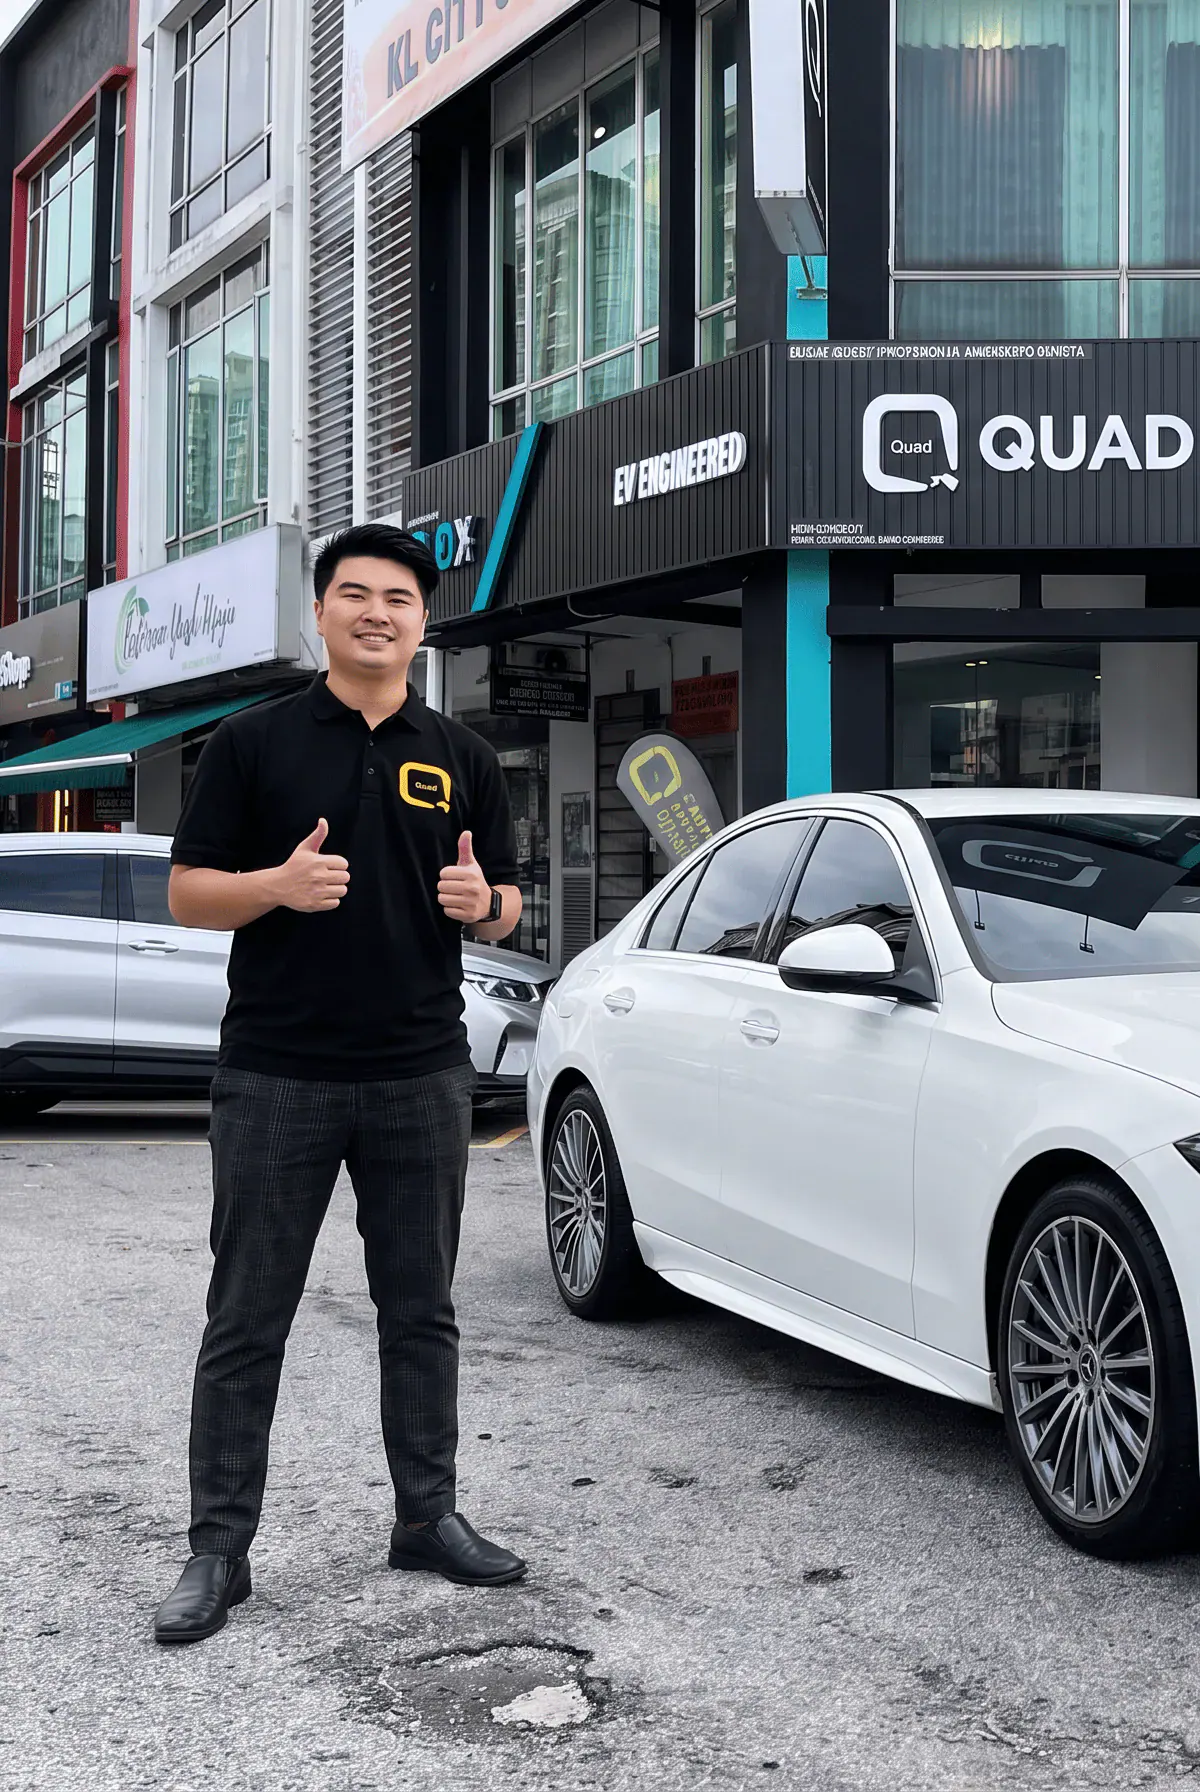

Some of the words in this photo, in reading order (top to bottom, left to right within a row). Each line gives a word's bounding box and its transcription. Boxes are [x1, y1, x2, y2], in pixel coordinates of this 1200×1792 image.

[387, 29, 419, 99] KL
[613, 462, 638, 507] EV
[637, 431, 747, 500] ENGINEERED
[890, 439, 933, 454] Quad
[979, 414, 1195, 472] QUAD
